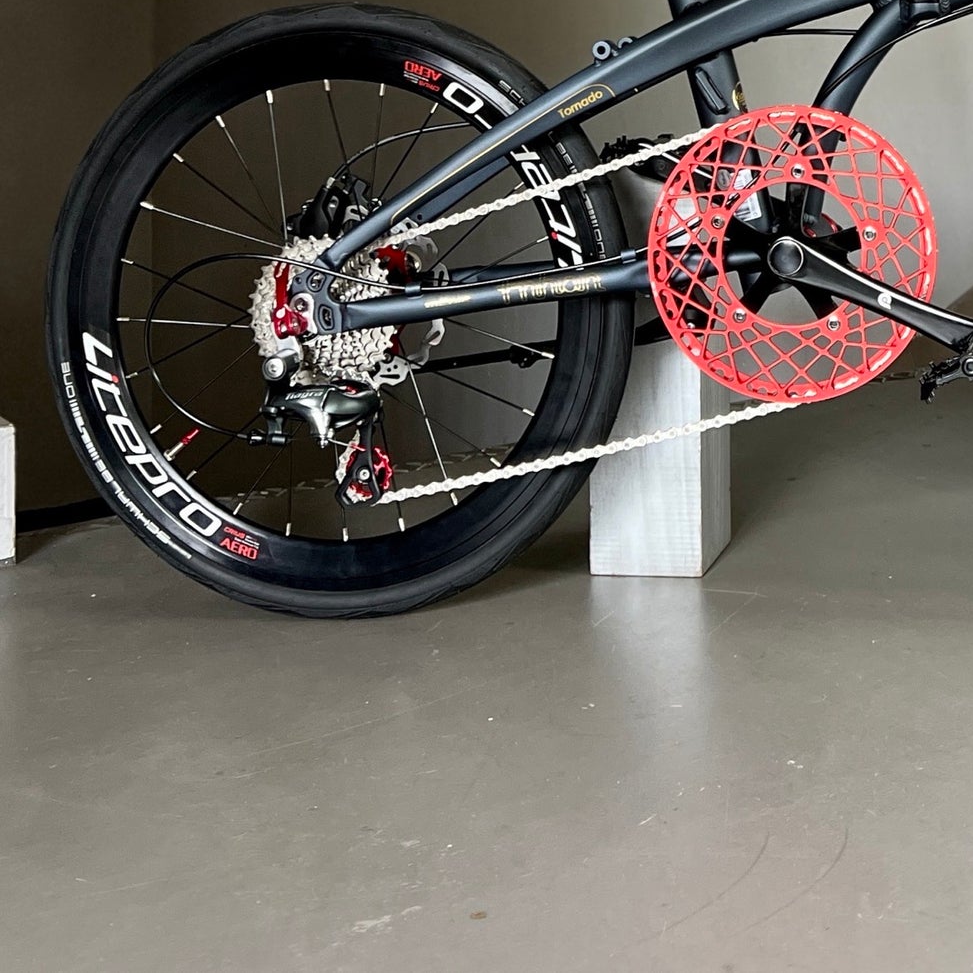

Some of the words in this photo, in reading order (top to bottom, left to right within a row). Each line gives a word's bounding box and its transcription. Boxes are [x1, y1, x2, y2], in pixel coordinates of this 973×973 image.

[404, 61, 442, 81] AERO
[557, 90, 604, 119] Tornado
[82, 331, 223, 537] Litepro
[220, 537, 258, 560] AERO
